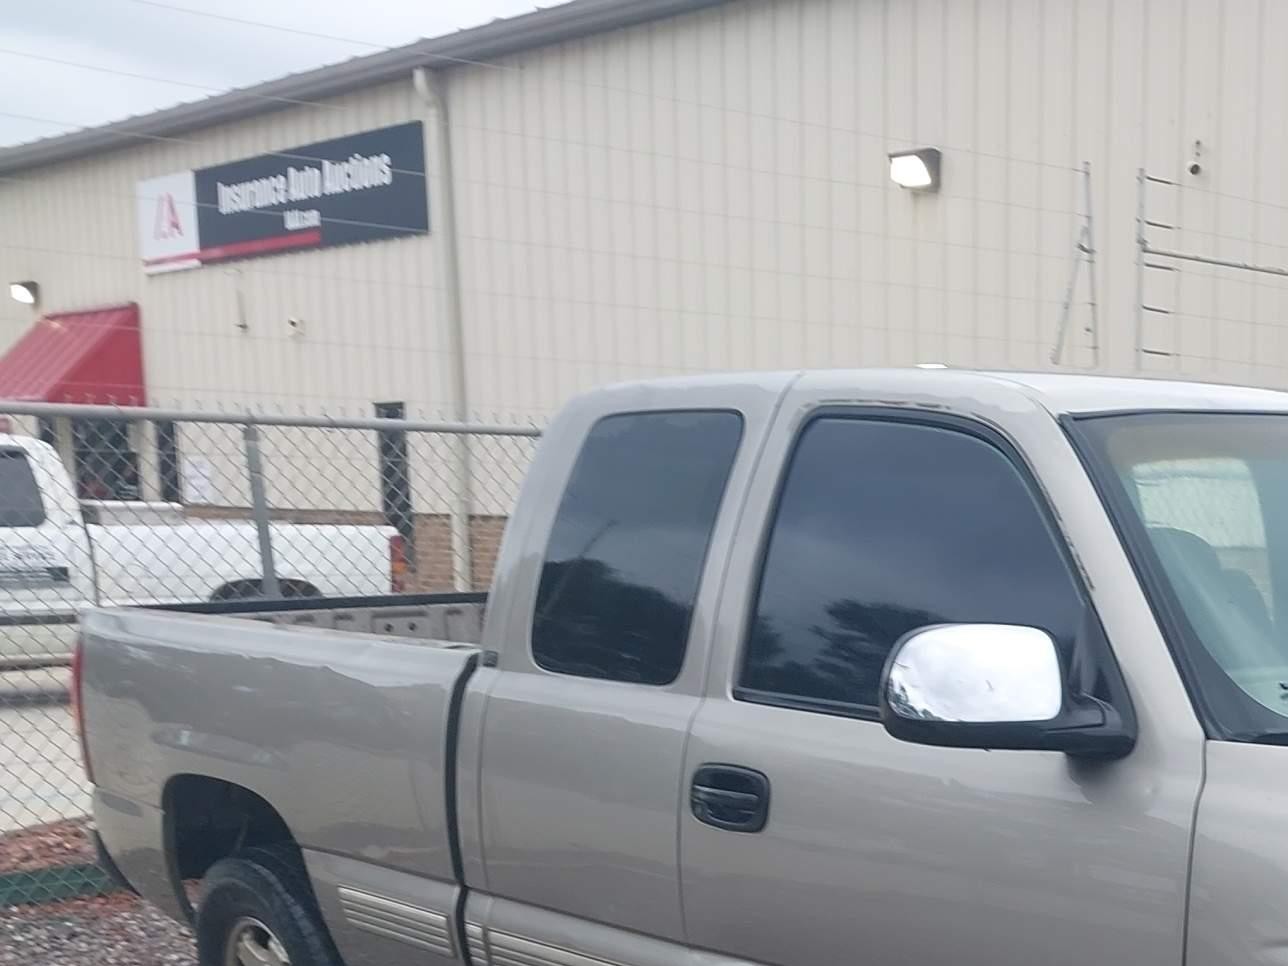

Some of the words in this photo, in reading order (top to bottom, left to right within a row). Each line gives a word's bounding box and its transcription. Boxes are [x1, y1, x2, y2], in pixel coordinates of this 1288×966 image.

[216, 174, 287, 215] Insurance
[287, 166, 322, 202] Auto
[322, 153, 393, 195] Auctions
